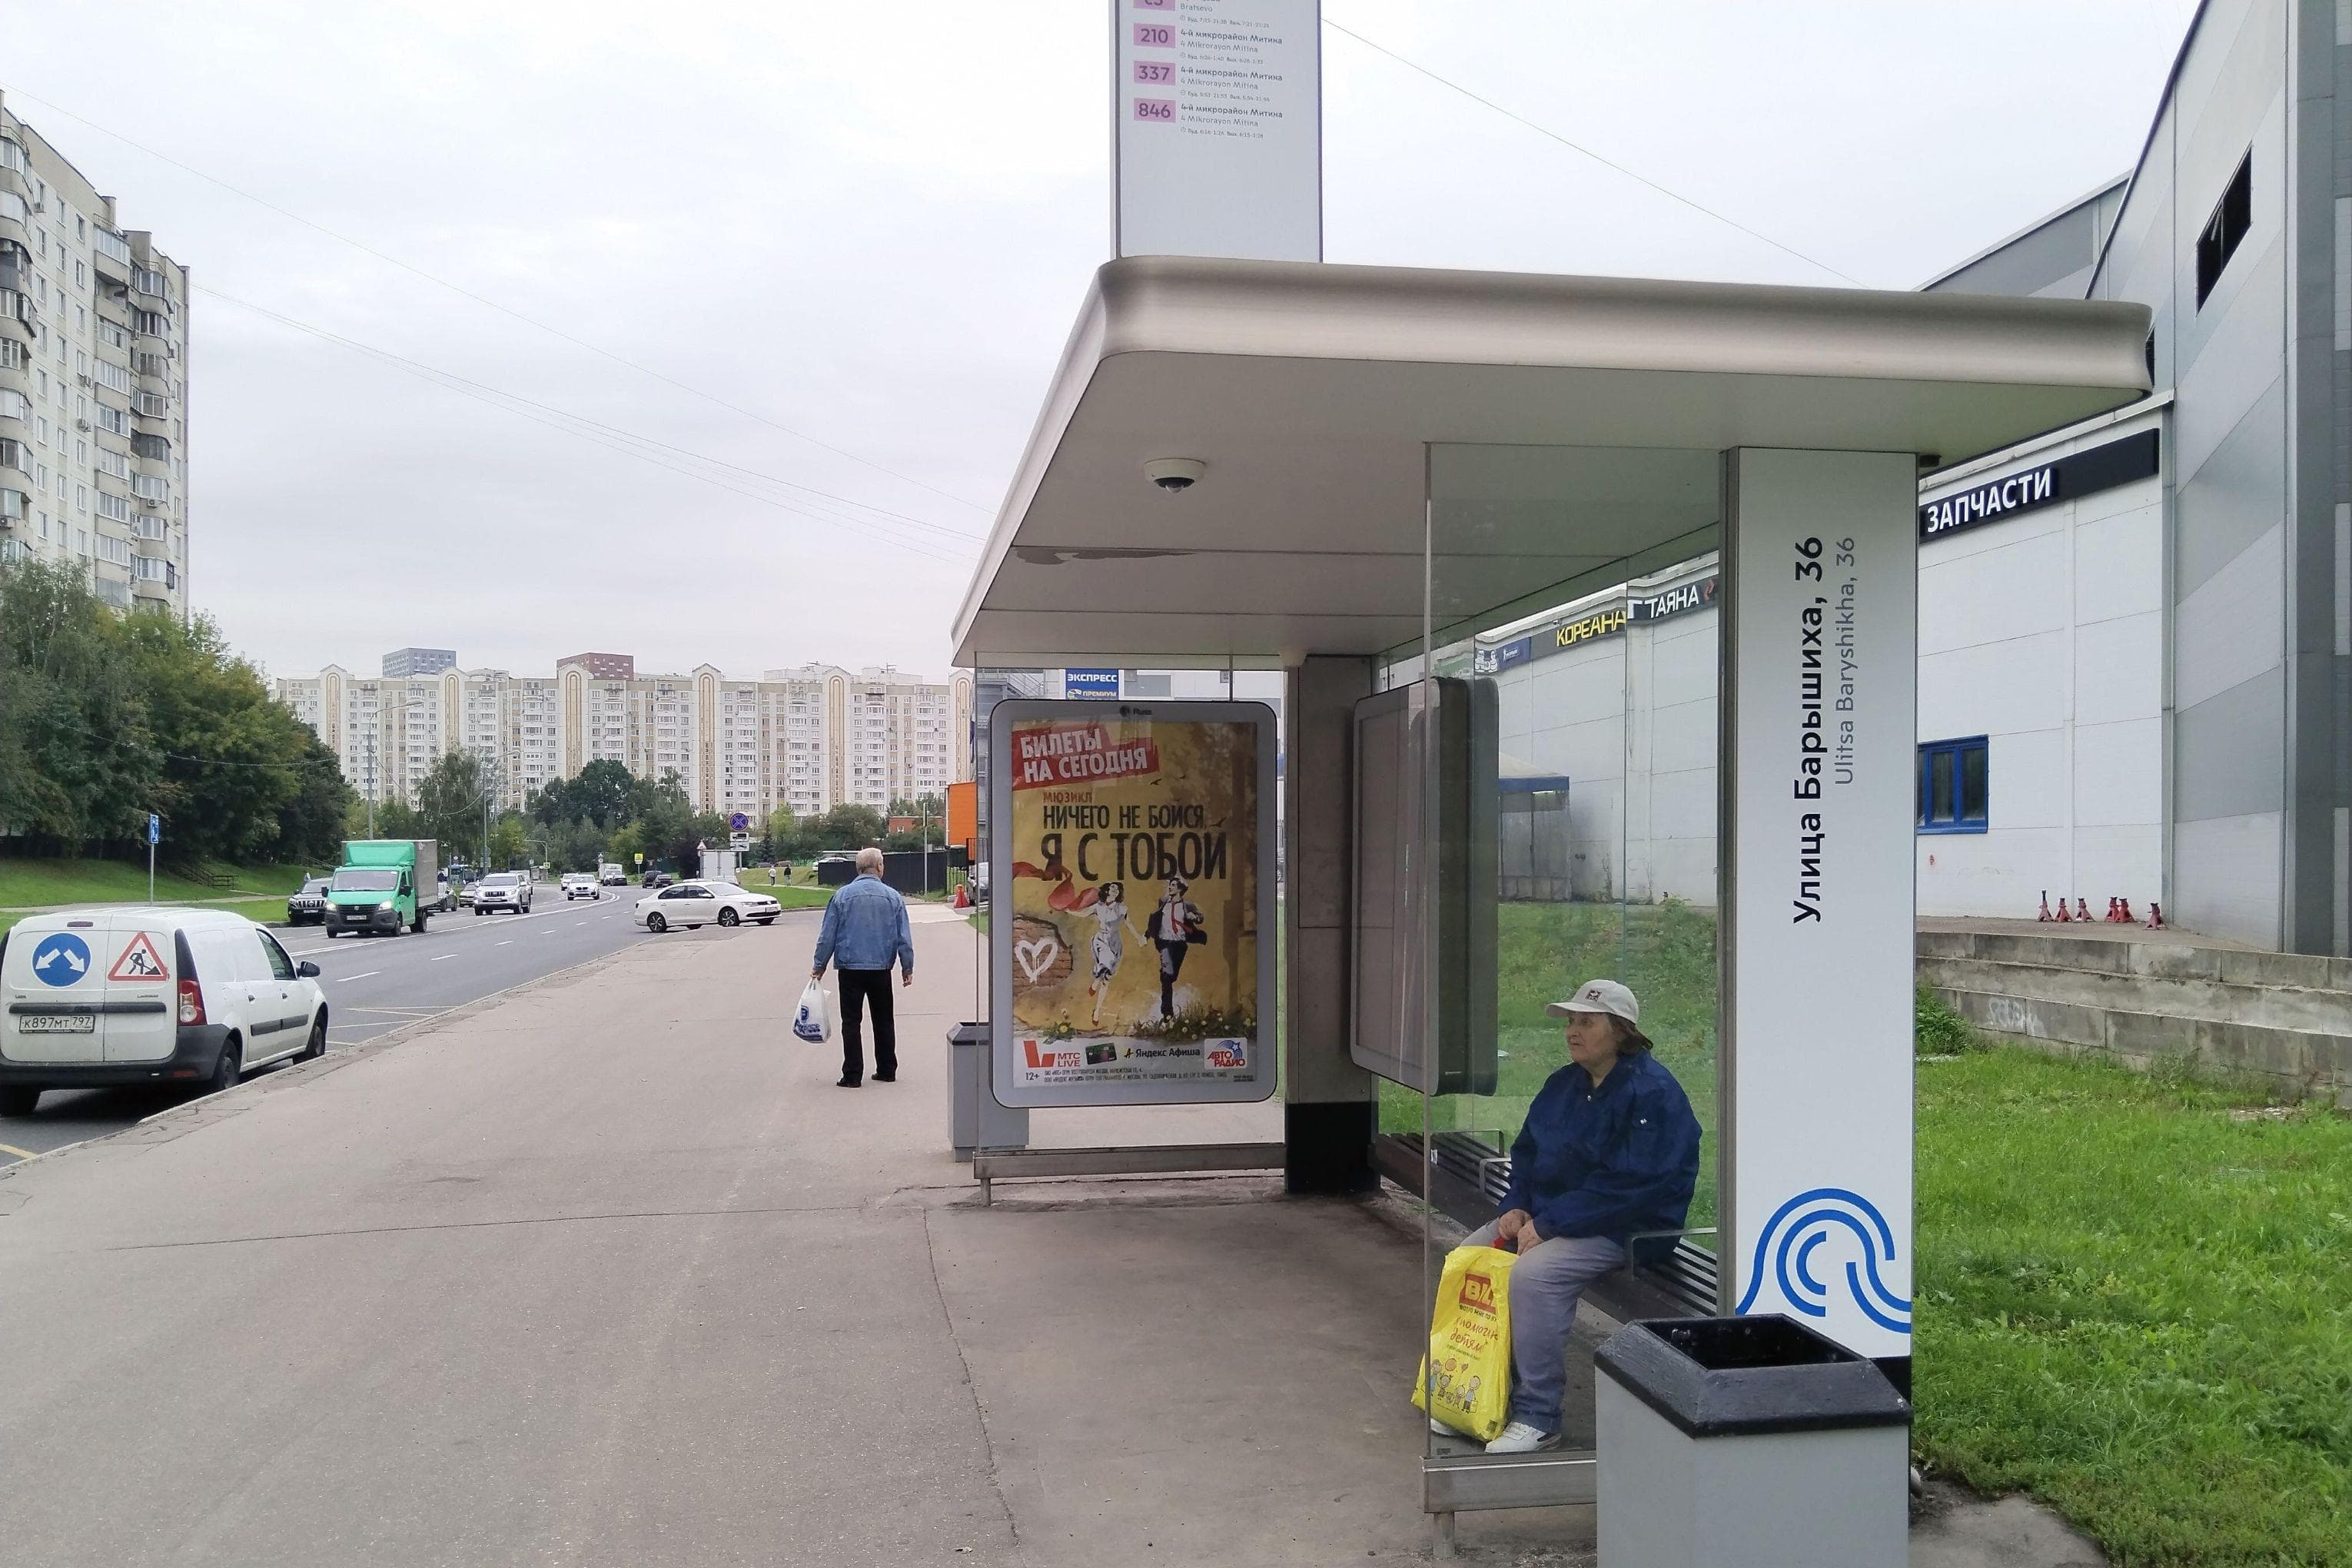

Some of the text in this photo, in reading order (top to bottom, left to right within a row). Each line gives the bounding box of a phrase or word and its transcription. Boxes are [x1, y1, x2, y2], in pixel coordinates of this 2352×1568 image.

[1140, 28, 1168, 44] 210
[1181, 28, 1283, 45] 4-й микрорайон Митина
[1188, 40, 1231, 52] Mikrorayon
[1232, 44, 1258, 53] Mitina
[1138, 65, 1170, 81] 337
[1195, 68, 1248, 79] микрорайон
[1250, 71, 1283, 81] Митина
[1188, 78, 1231, 90] Mikrorayon
[1232, 81, 1258, 91] Mitina
[1138, 102, 1171, 119] 846
[1195, 106, 1248, 117] микрорайон
[1250, 109, 1283, 119] Митина
[1188, 115, 1231, 128] Mikrorayon
[1232, 119, 1258, 128] Mitina
[1927, 467, 2051, 533] ЗАПЧАСТИ
[1556, 610, 1626, 647] КОРЕАНА
[1835, 537, 1859, 786] Ulitsa Baryshikha, 36
[1067, 673, 1118, 683] ЭКСПРЕСС
[1793, 536, 1829, 924] Улица Барышиха, 36
[1020, 728, 1101, 759] БИЛЕТЫ
[1024, 747, 1148, 783] НА СЕГОДНЯ
[1043, 790, 1093, 803] МЮЗИКЛ
[1043, 805, 1110, 829] НИЧЕГО
[1119, 805, 1141, 829] НЕ
[1041, 833, 1062, 882] Я
[1078, 832, 1099, 882] С
[1135, 1048, 1201, 1058] Яндекс Афиша
[1207, 1051, 1233, 1060] АВТО
[1214, 1058, 1246, 1068] РАДИО
[1025, 1072, 1040, 1081] 12+
[1464, 1279, 1494, 1306] BIL
